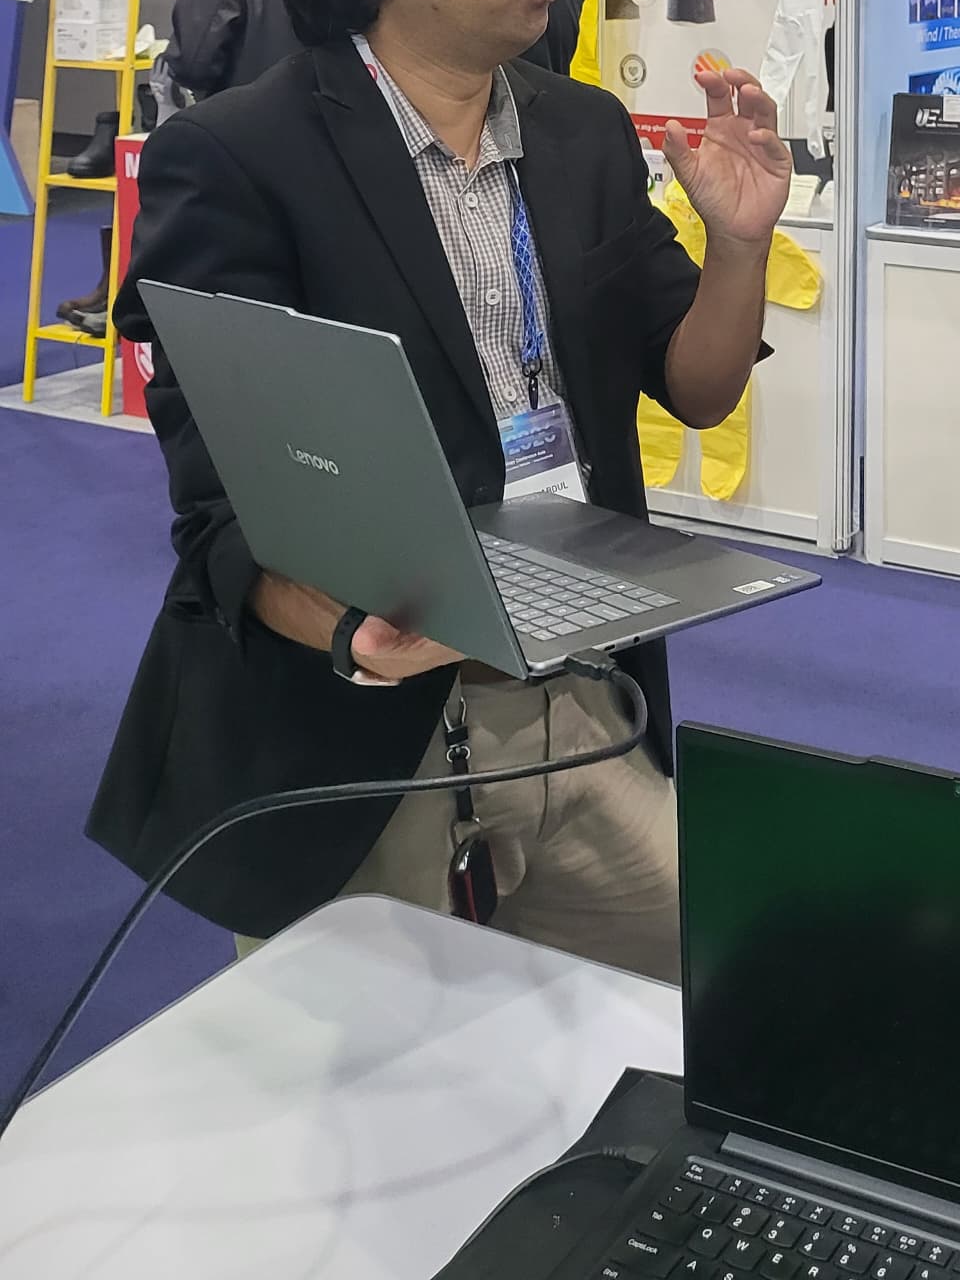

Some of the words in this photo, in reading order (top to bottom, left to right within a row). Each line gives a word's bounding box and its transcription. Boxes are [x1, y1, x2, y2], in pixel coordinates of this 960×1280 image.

[286, 442, 340, 476] Lenovo
[736, 1239, 750, 1251] W
[771, 1253, 783, 1265] E
[686, 1260, 698, 1272] A
[807, 1265, 819, 1278] R
